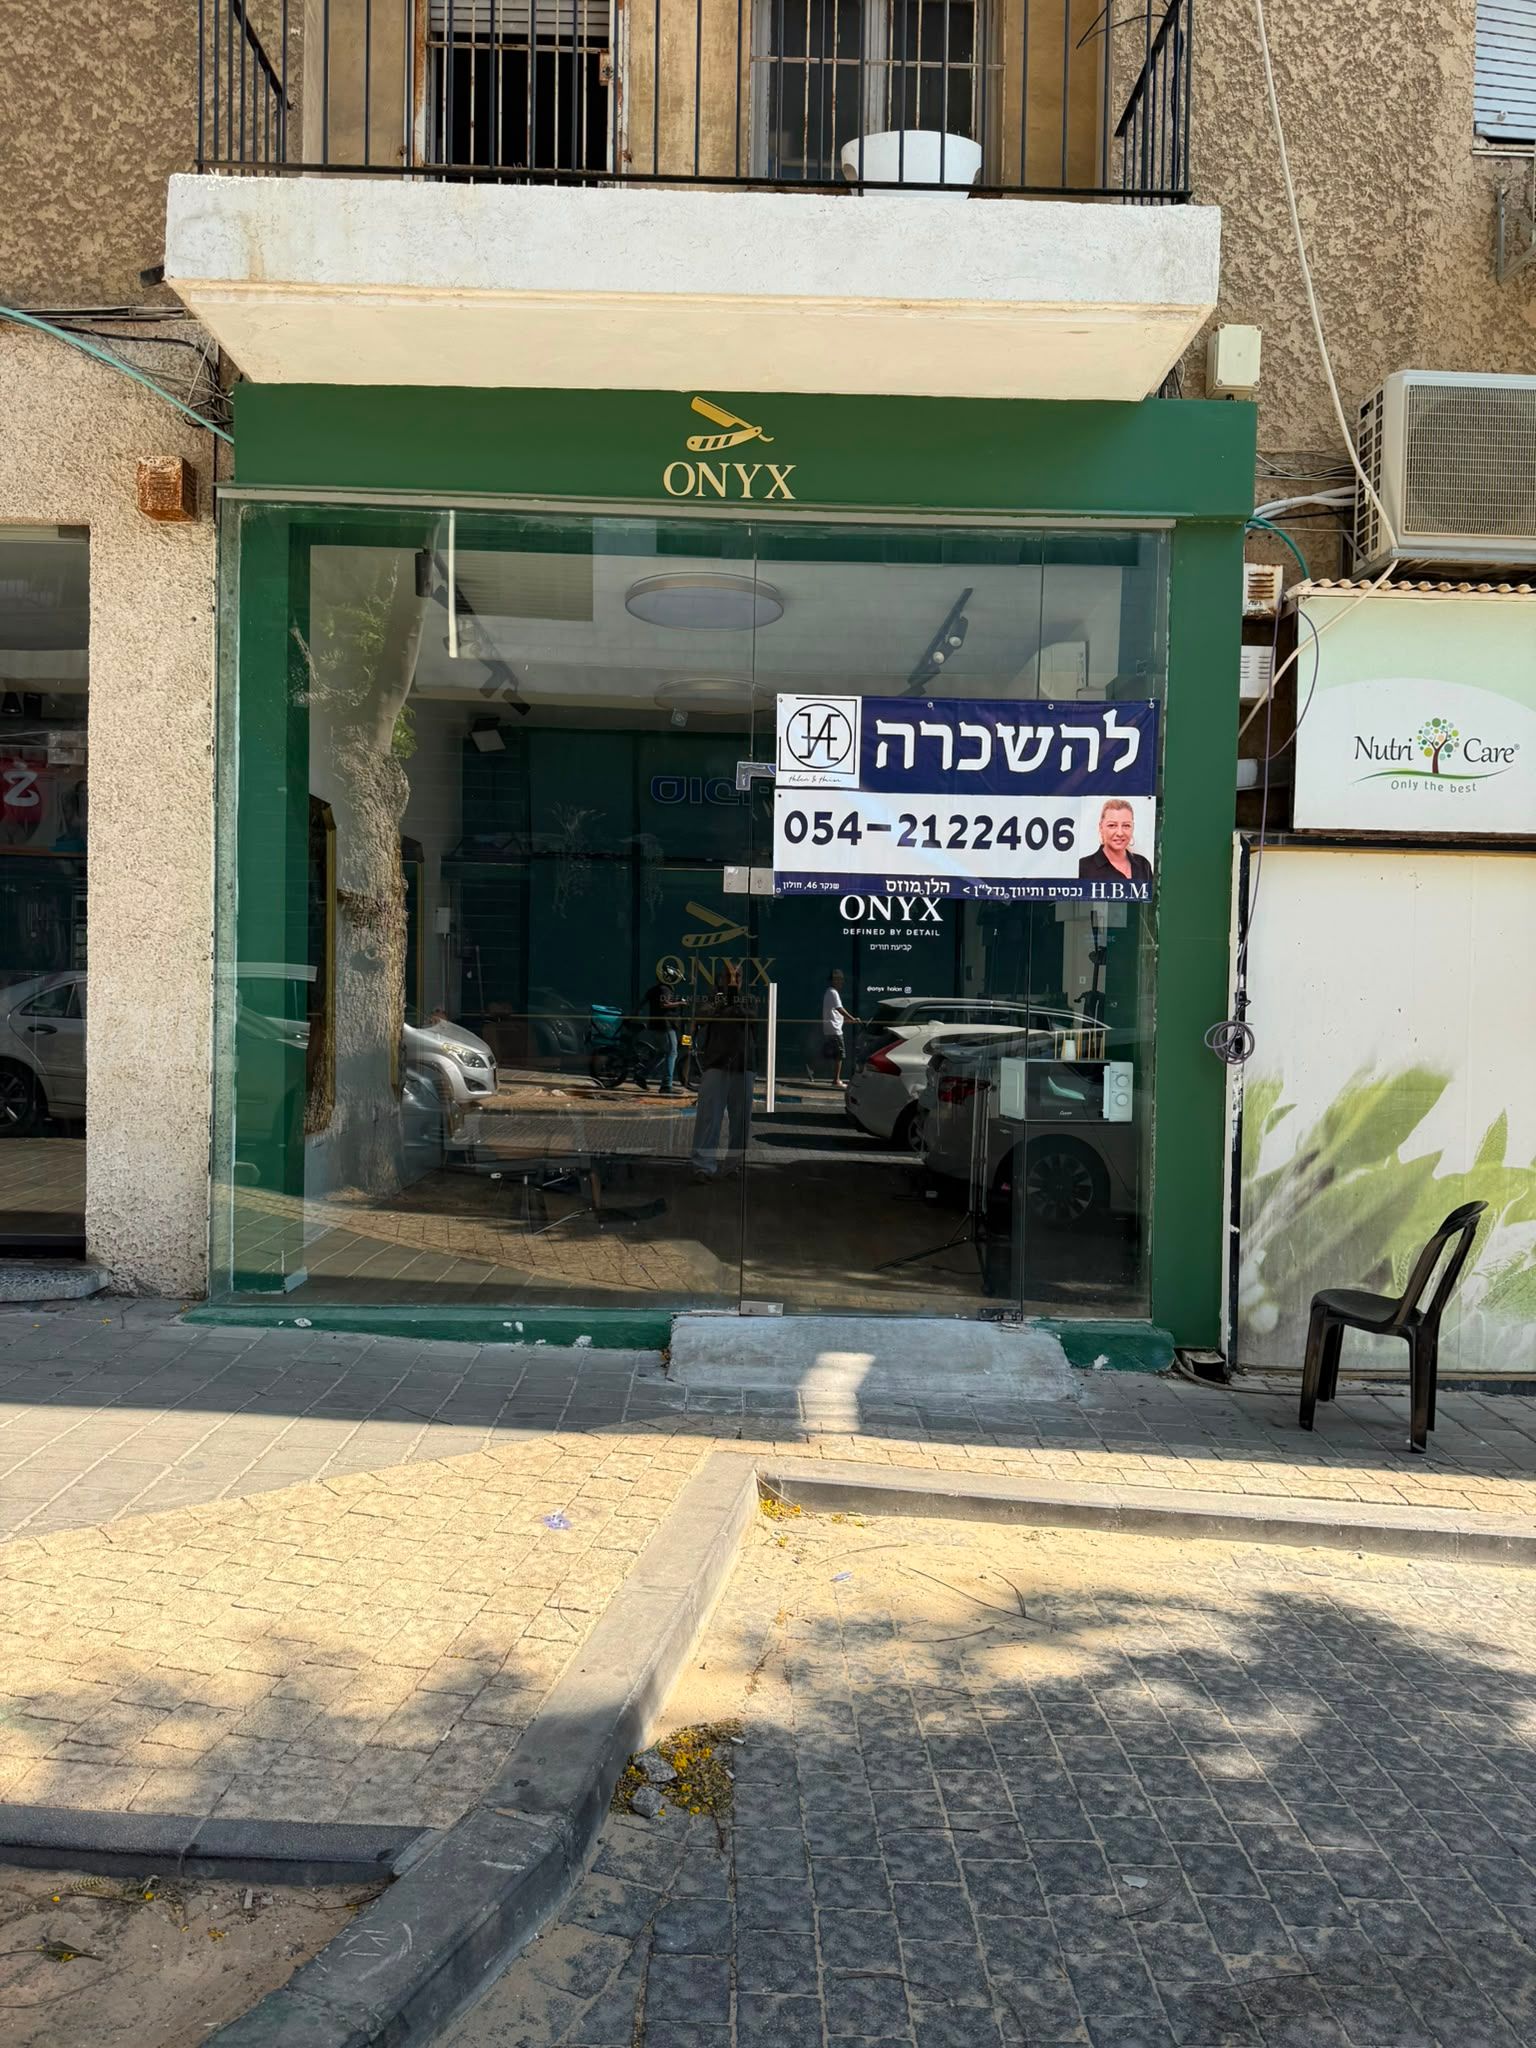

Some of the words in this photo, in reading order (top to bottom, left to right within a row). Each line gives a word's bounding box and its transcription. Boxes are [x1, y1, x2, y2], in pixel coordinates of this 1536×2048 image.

[663, 461, 797, 500] ONYX
[875, 709, 1141, 774] להשכרה
[1354, 735, 1414, 761] Nutri
[1391, 780, 1419, 792] Only
[1424, 781, 1444, 793] the
[1450, 783, 1478, 794] best
[783, 809, 1076, 853] 054-2122406
[885, 880, 920, 894] מוזס
[925, 878, 950, 895] הלן
[1009, 886, 1044, 899] ותיווך
[1048, 886, 1083, 897] נכסים
[839, 894, 944, 921] ONYX
[843, 928, 886, 936] DEFINED
[906, 929, 941, 937] DETAIL
[656, 954, 777, 988] ONYX
